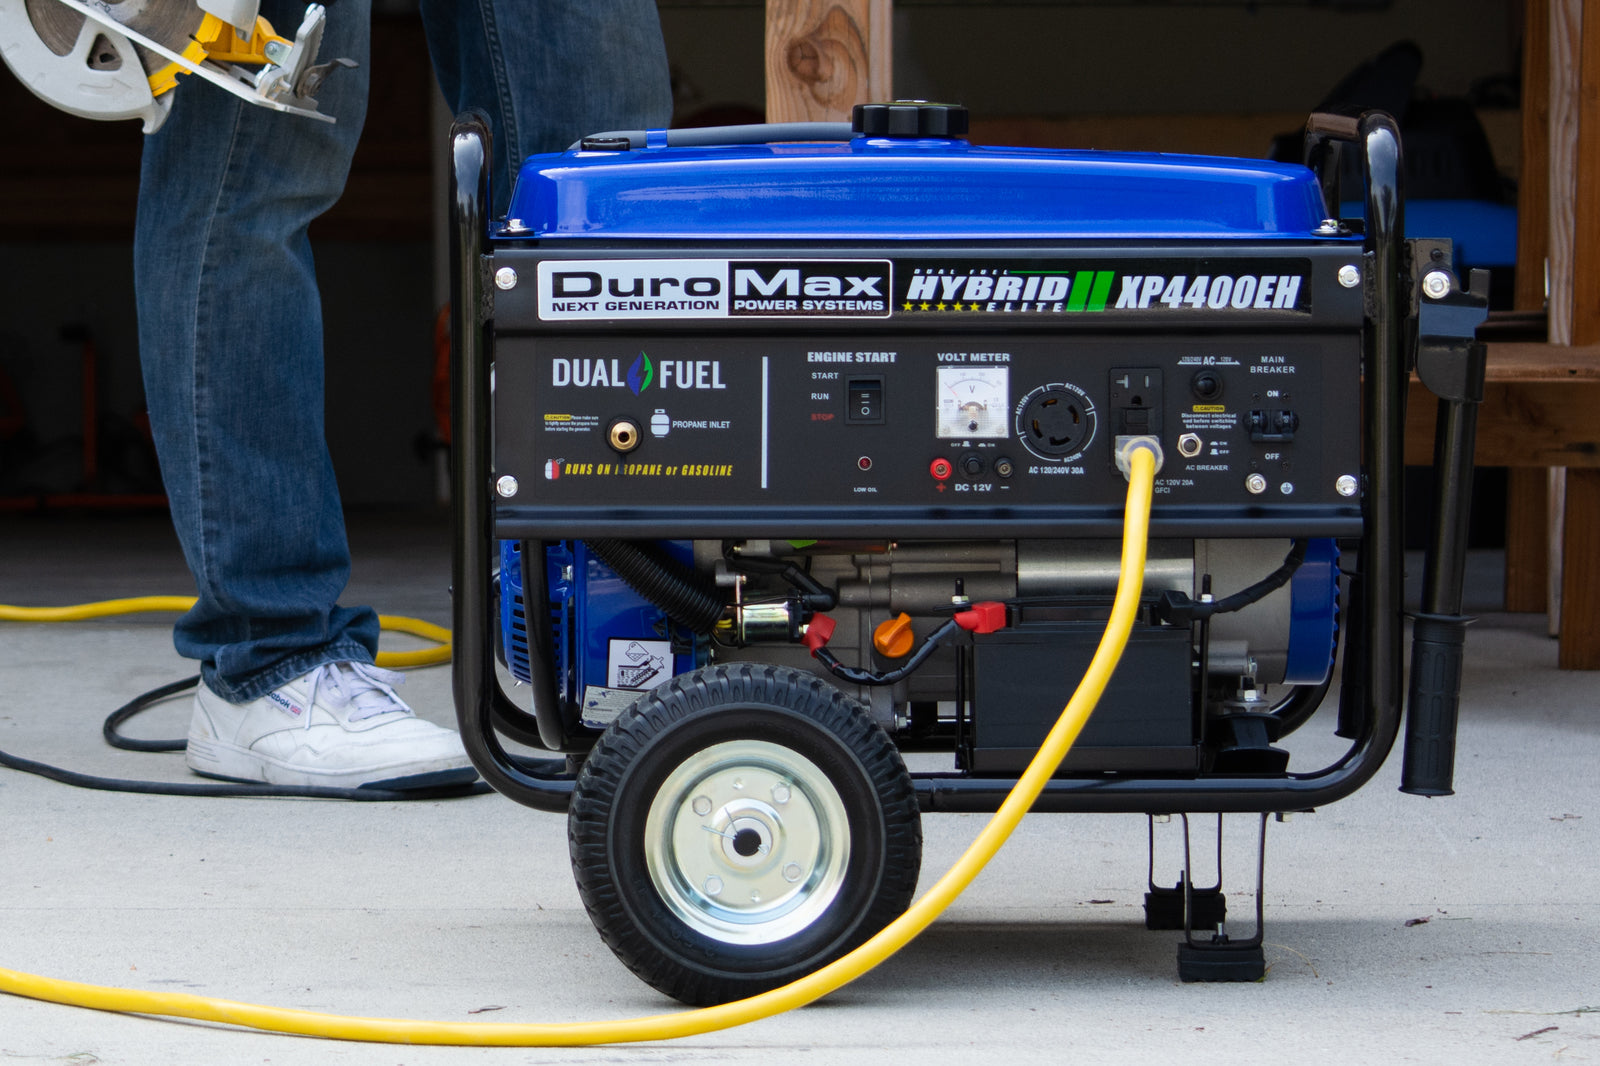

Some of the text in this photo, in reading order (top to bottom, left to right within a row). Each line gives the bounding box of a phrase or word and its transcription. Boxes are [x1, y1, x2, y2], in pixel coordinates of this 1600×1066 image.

[906, 275, 1072, 300] HYBRID
[1115, 275, 1302, 309] XP4400EH
[552, 300, 720, 312] NEXT GENERATION
[734, 300, 884, 311] POWER SYSTEMS
[985, 302, 1064, 312] ELITE
[807, 352, 897, 362] ENGINE START
[937, 353, 1011, 362] VOLT METER
[1203, 356, 1215, 365] AC
[552, 358, 727, 389] DUAL FUEL
[1250, 366, 1296, 374] BREAKER
[811, 372, 839, 380] START
[968, 385, 975, 393] V
[811, 413, 834, 421] STOP
[672, 421, 731, 429] PROPANE INLET
[565, 463, 593, 475] RUNS
[597, 463, 611, 475] ON
[666, 466, 678, 476] or
[681, 464, 733, 476] GASOLINE
[1028, 466, 1084, 474] AC 120/240V 30A
[955, 484, 992, 492] DC 12V
[266, 690, 290, 709] ebok
